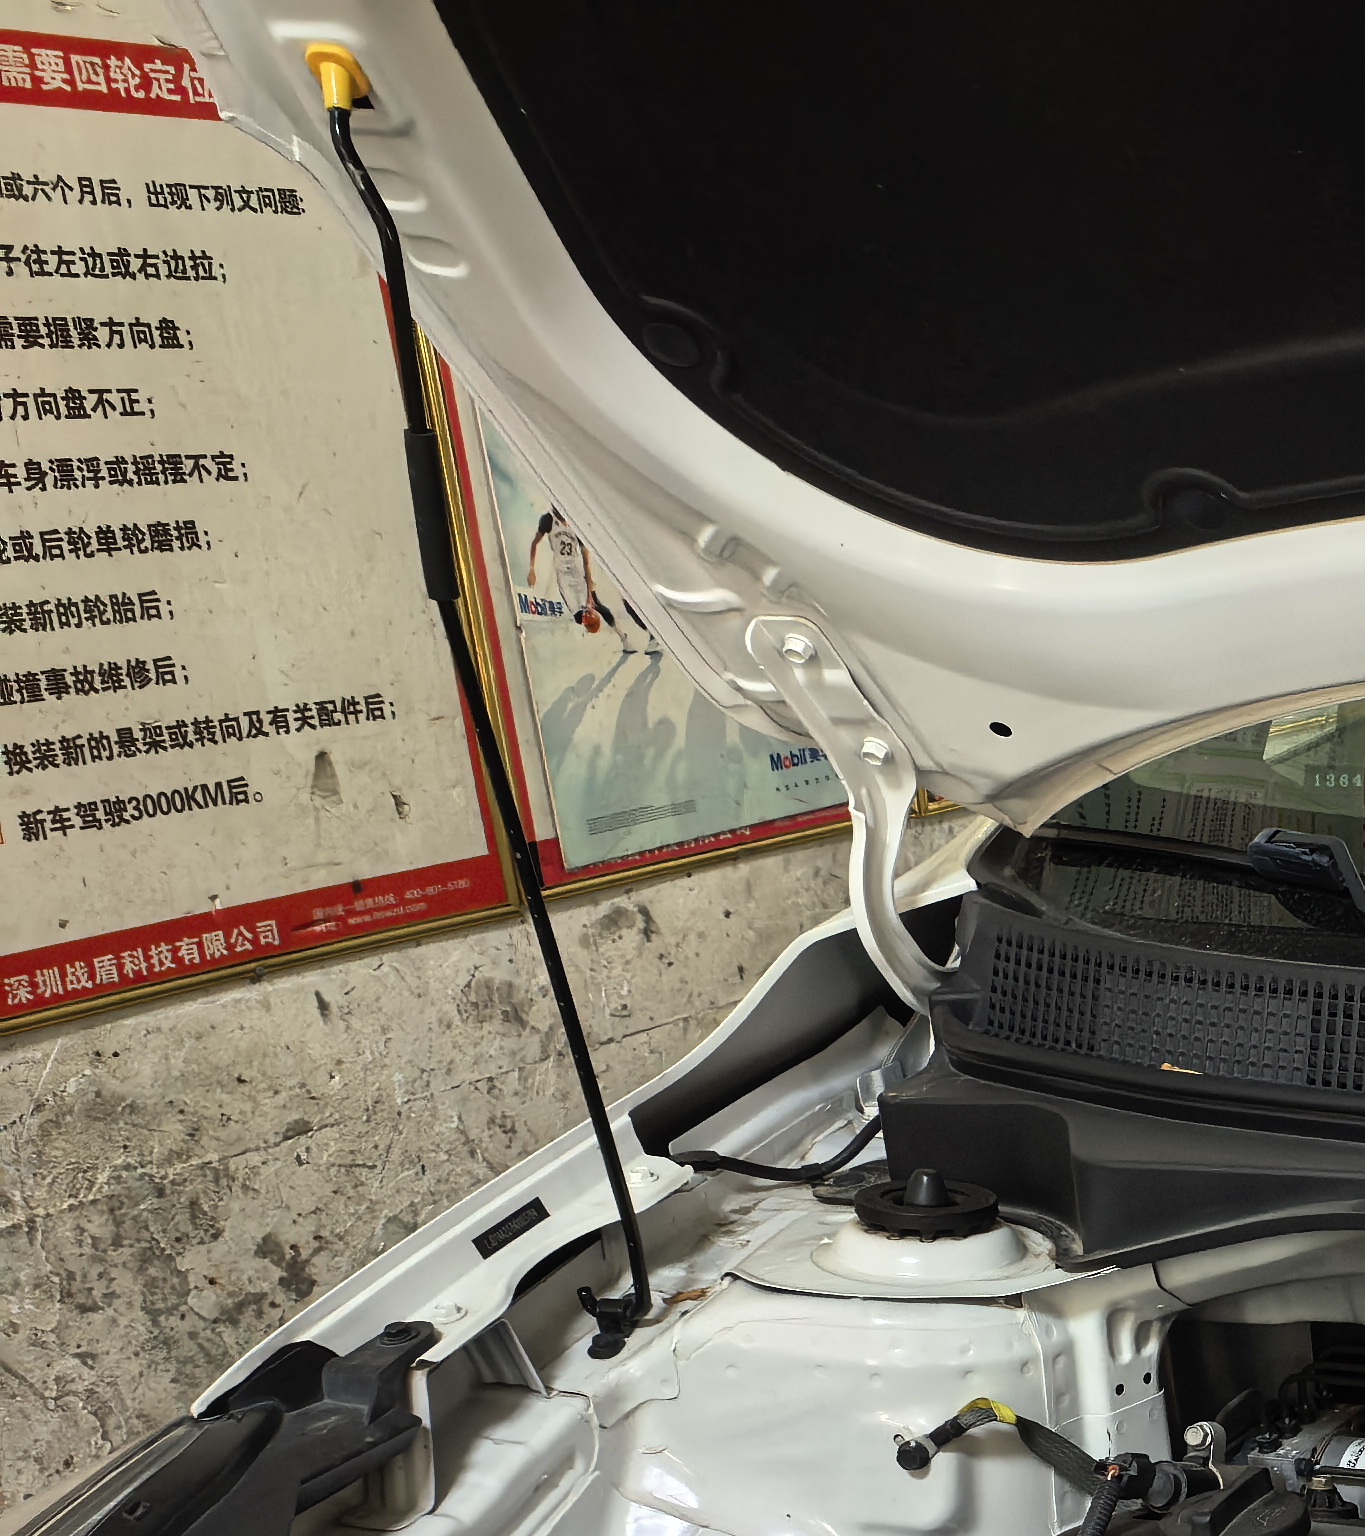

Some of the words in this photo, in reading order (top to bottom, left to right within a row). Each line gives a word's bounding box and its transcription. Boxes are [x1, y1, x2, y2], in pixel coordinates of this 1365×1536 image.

[0, 387, 155, 420] 方向盘不正；
[3, 920, 280, 1006] 深圳战盾科技有限公司
